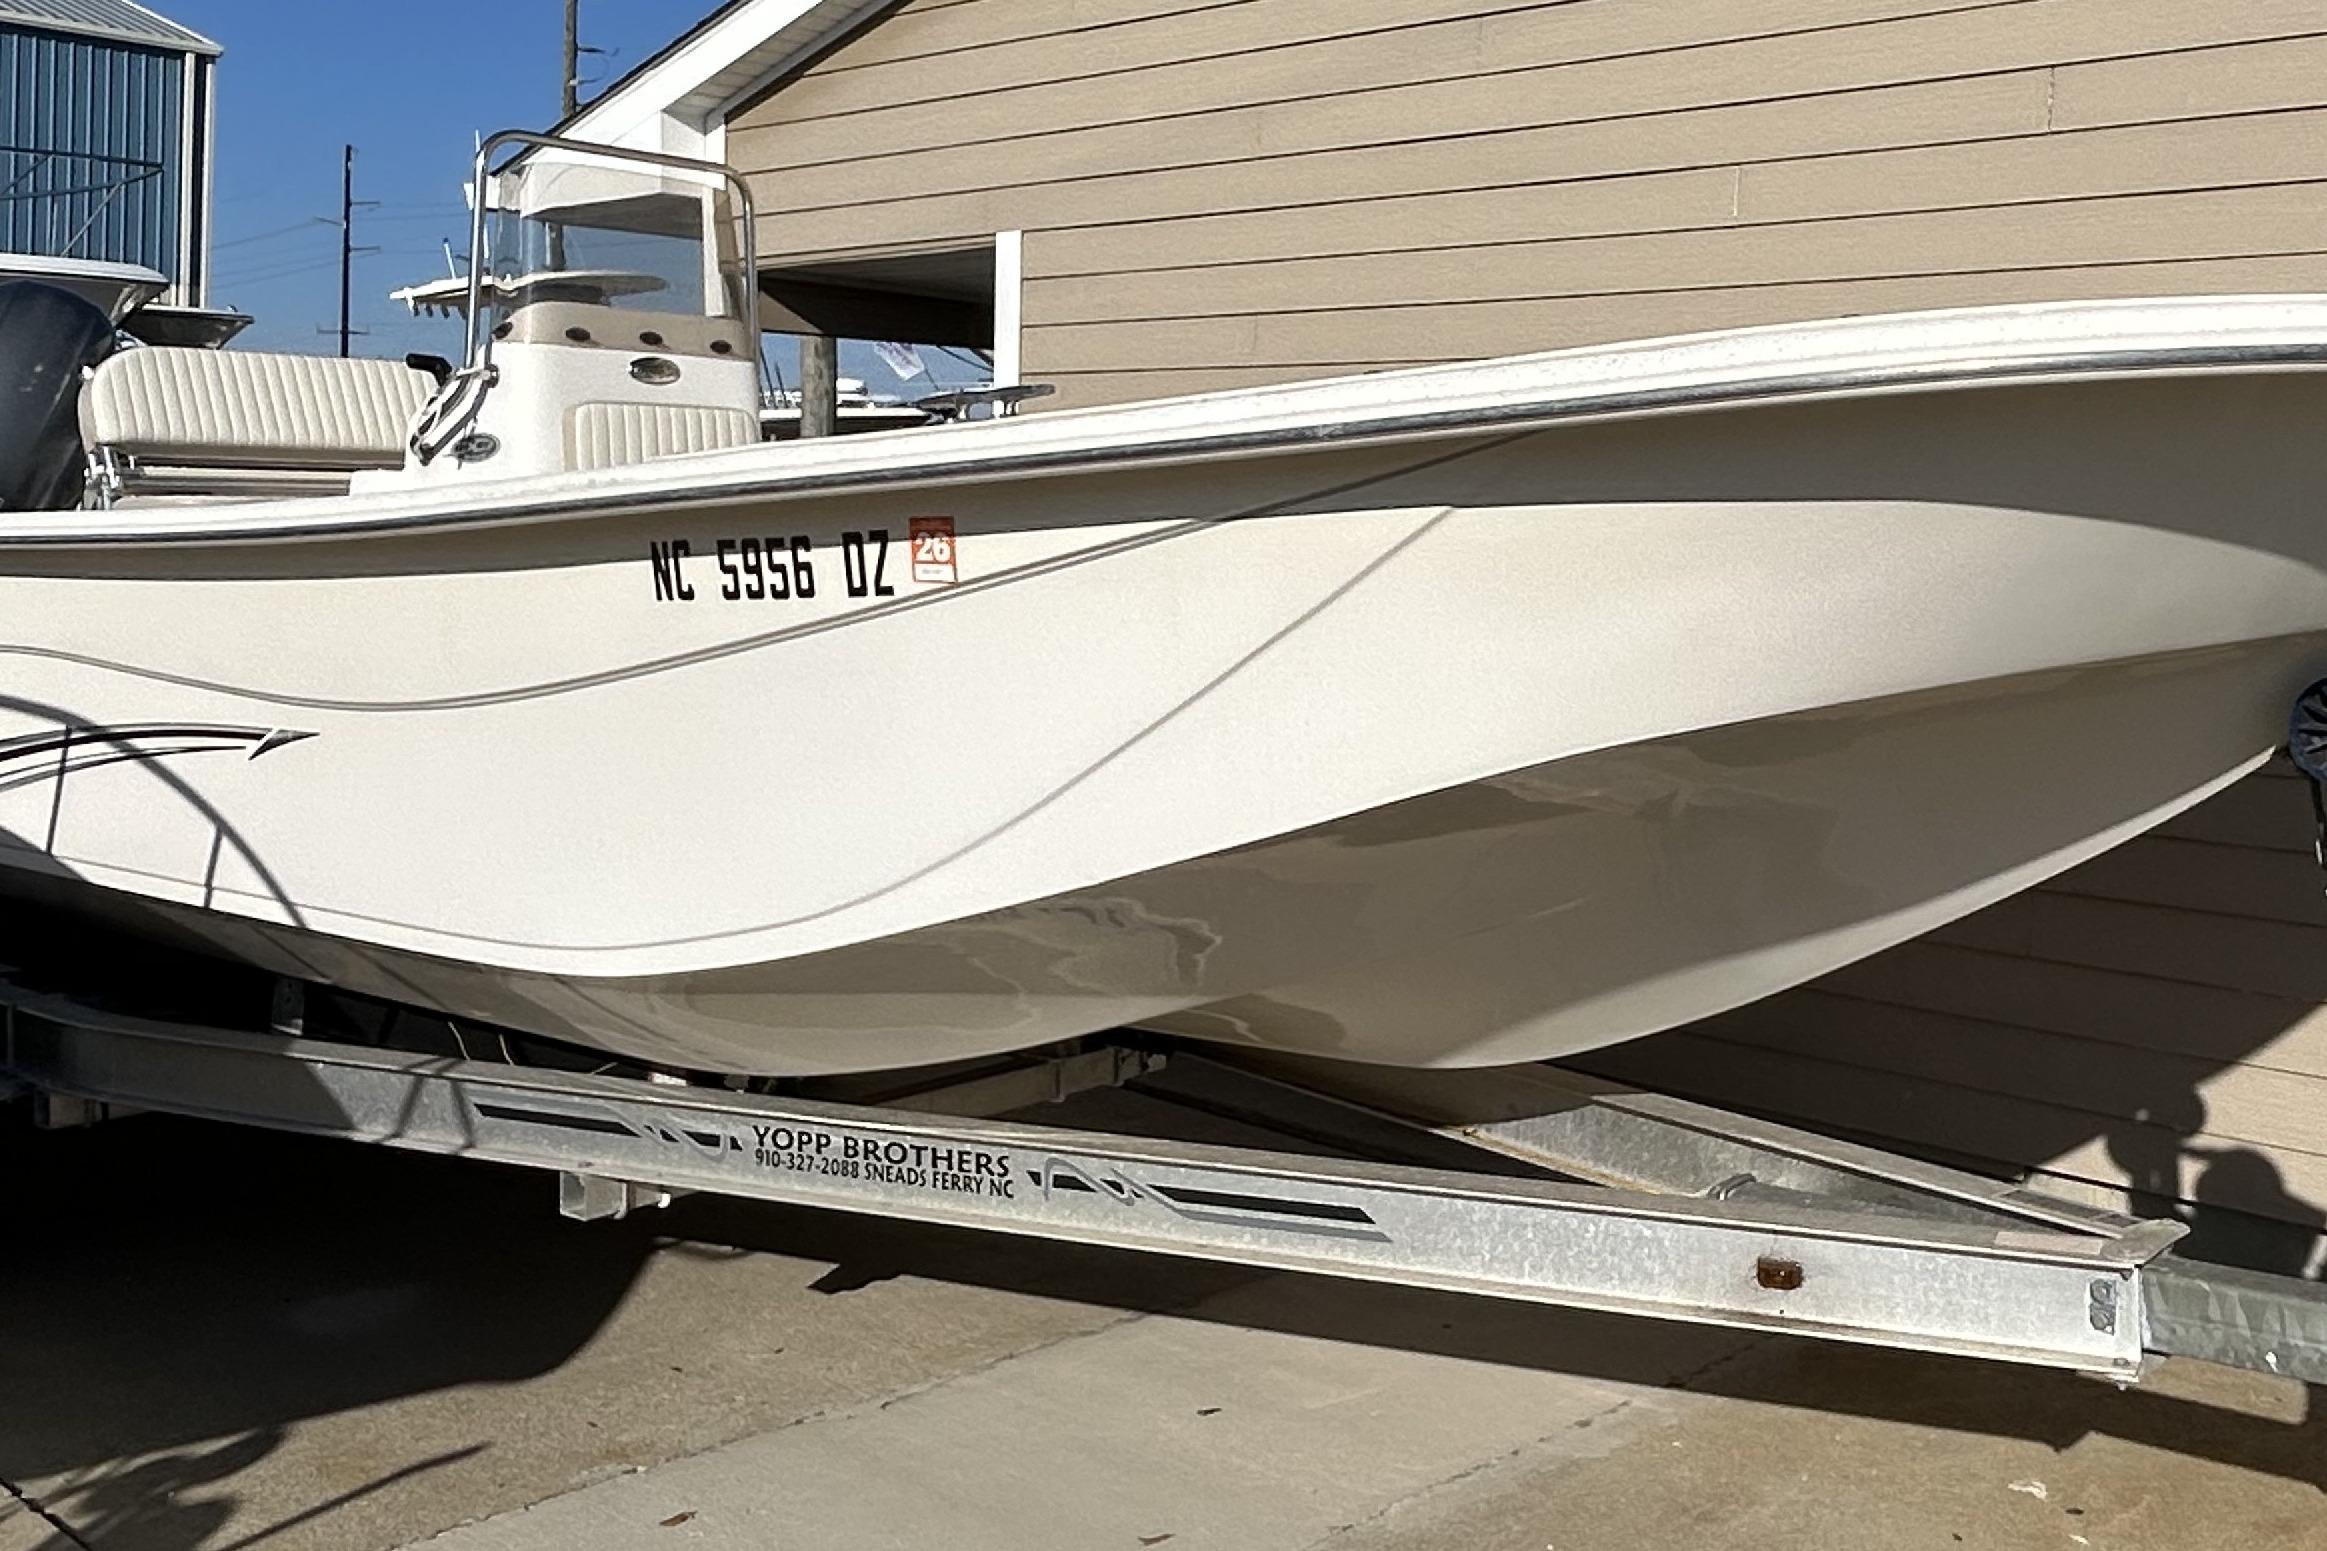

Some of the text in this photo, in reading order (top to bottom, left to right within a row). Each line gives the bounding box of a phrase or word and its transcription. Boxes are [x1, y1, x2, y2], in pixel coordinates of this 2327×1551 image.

[651, 529, 894, 602] NC 5956 DZ
[915, 531, 951, 562] 26
[752, 1125, 1010, 1178] YOPP BROTHERS
[755, 1148, 1014, 1199] 910-327-2088 SNEADS FERRY NC
